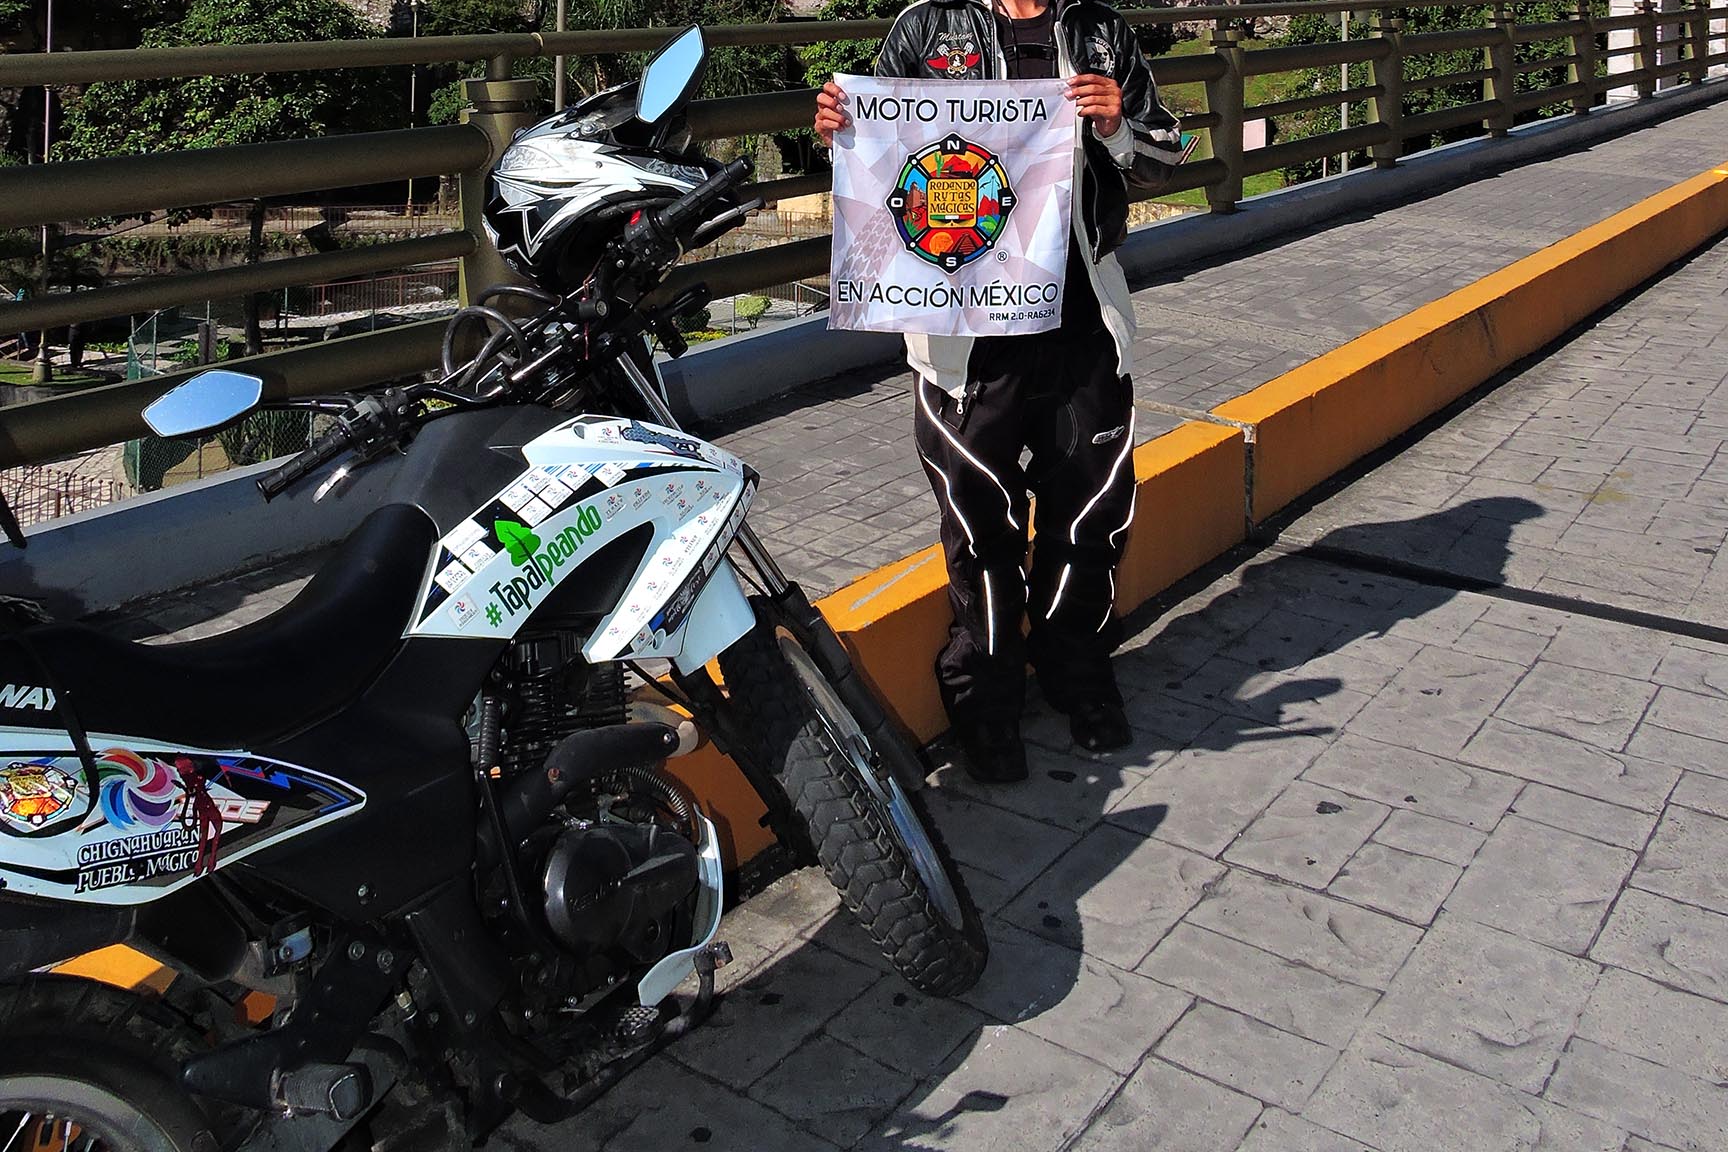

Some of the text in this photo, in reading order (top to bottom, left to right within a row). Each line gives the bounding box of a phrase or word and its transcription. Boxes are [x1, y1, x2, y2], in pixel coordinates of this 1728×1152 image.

[856, 95, 1048, 124] MOTO TURISTA
[946, 140, 960, 151] N
[1001, 196, 1012, 207] E
[945, 256, 957, 267] S
[837, 279, 1059, 309] EN ACCIÓN MÉXICO
[989, 312, 1009, 321] RRM
[484, 504, 603, 628] #Tapalpeando
